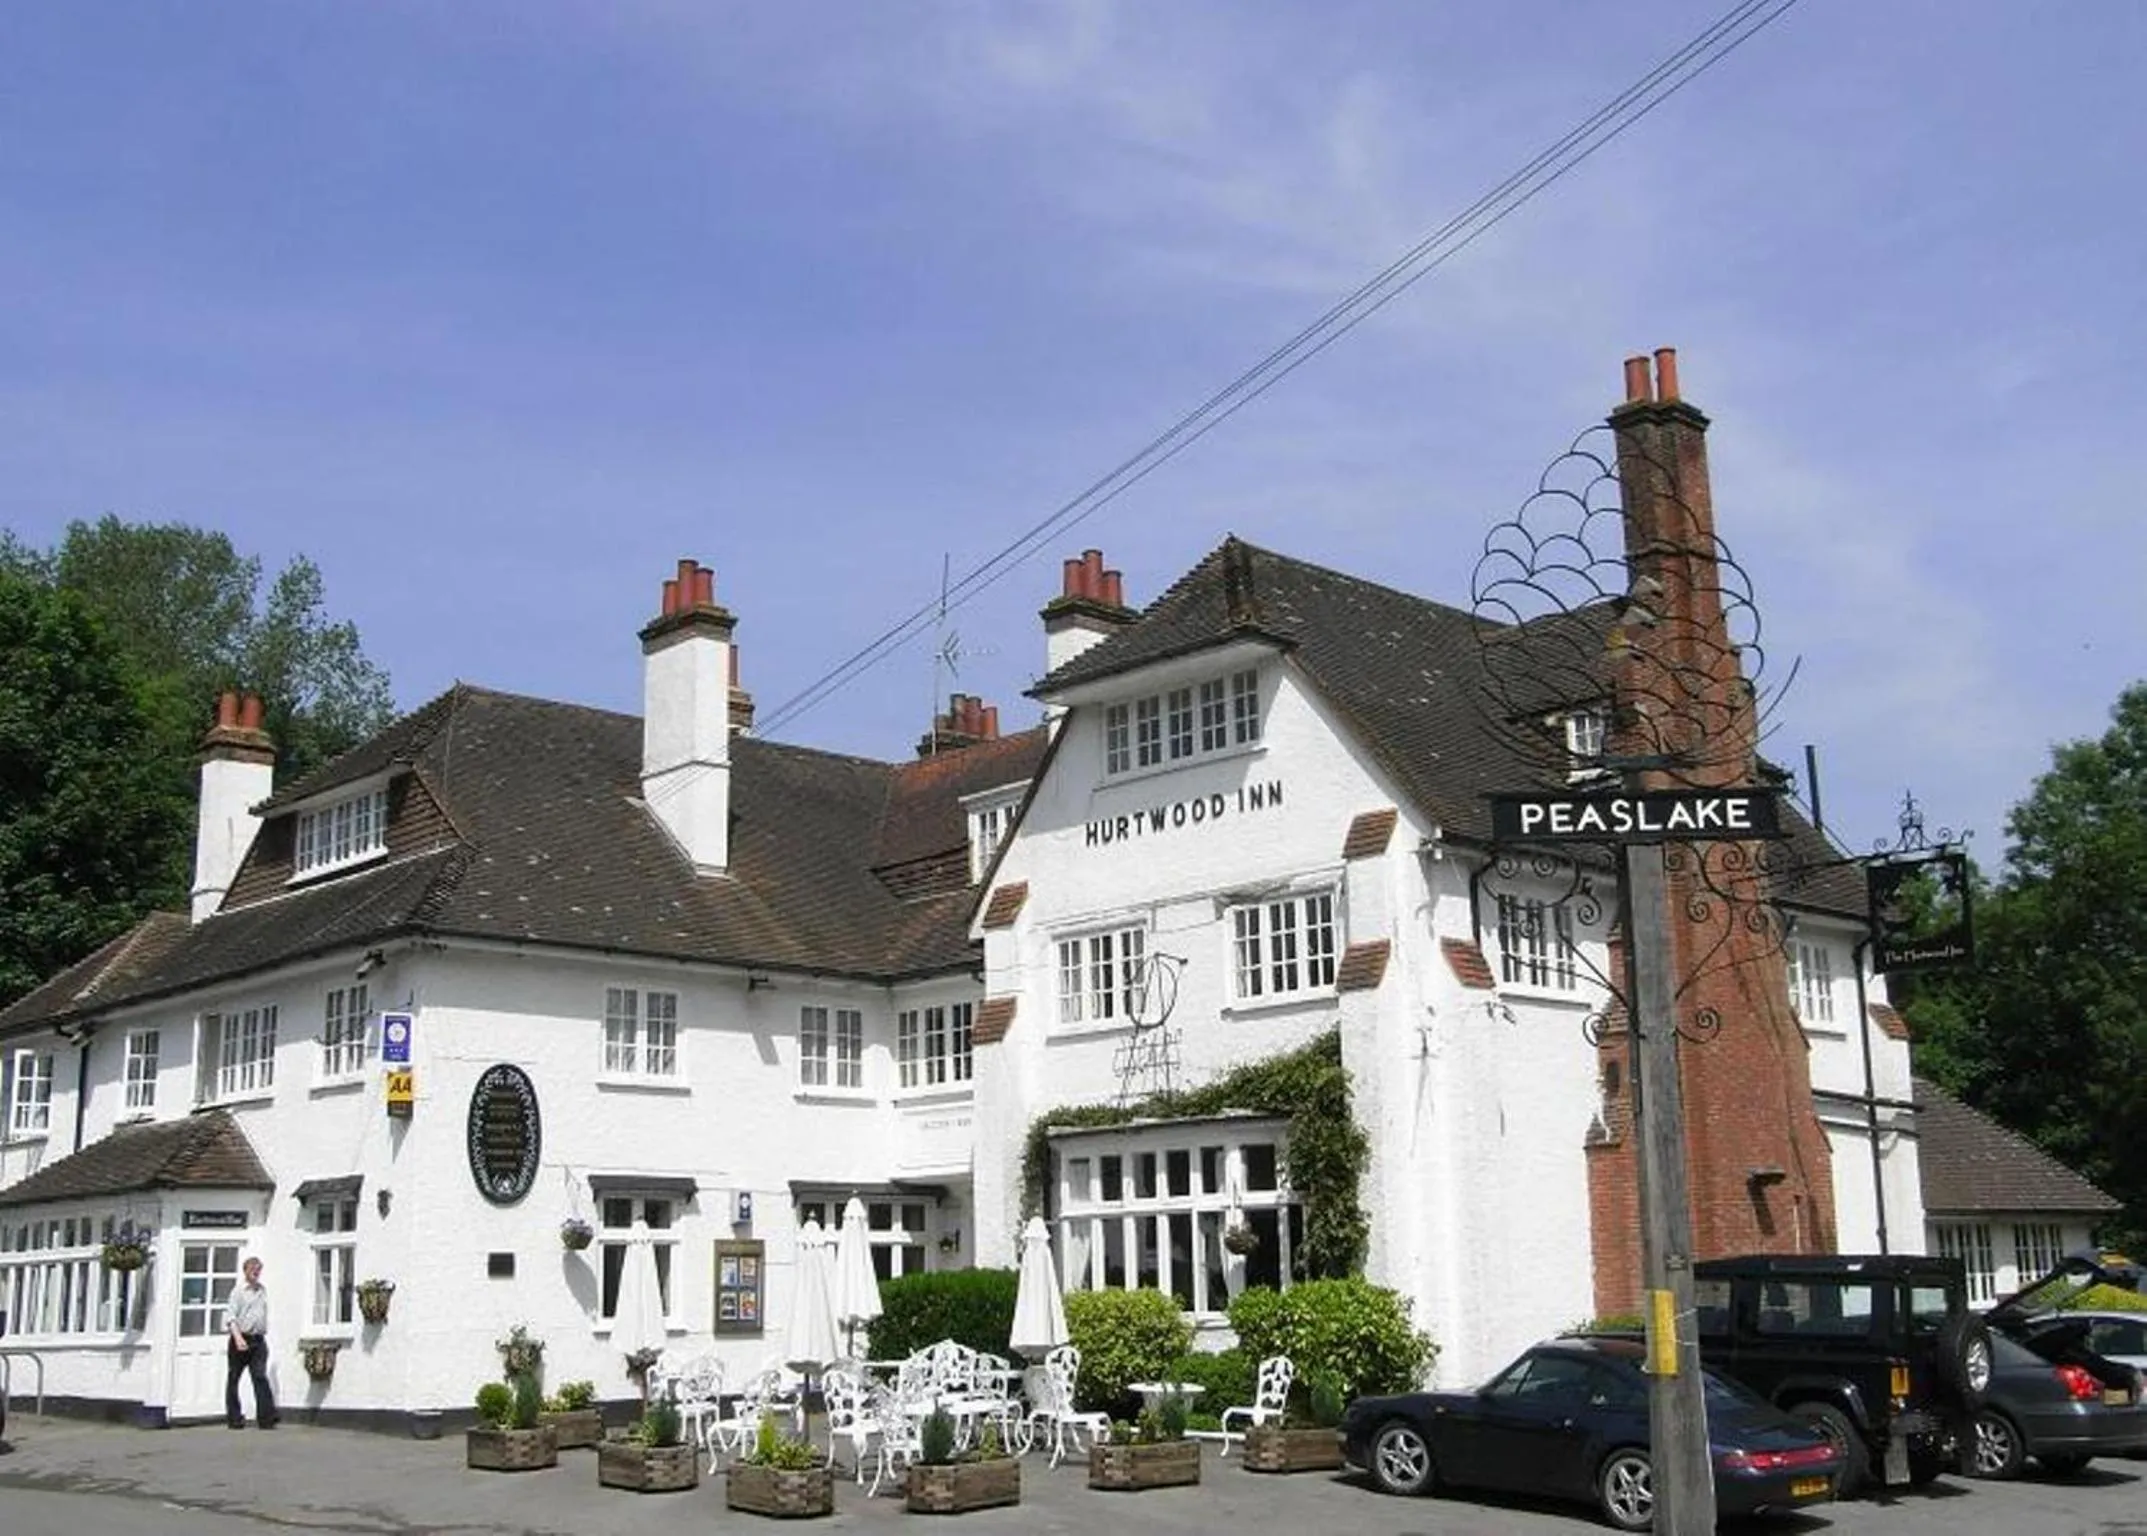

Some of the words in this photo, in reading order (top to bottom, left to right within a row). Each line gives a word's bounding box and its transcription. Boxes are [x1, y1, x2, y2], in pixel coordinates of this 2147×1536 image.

[1086, 792, 1225, 848] HURTWOOD
[1237, 779, 1282, 813] INN
[1520, 799, 1752, 834] PEASLAKE
[390, 1076, 412, 1094] AA
